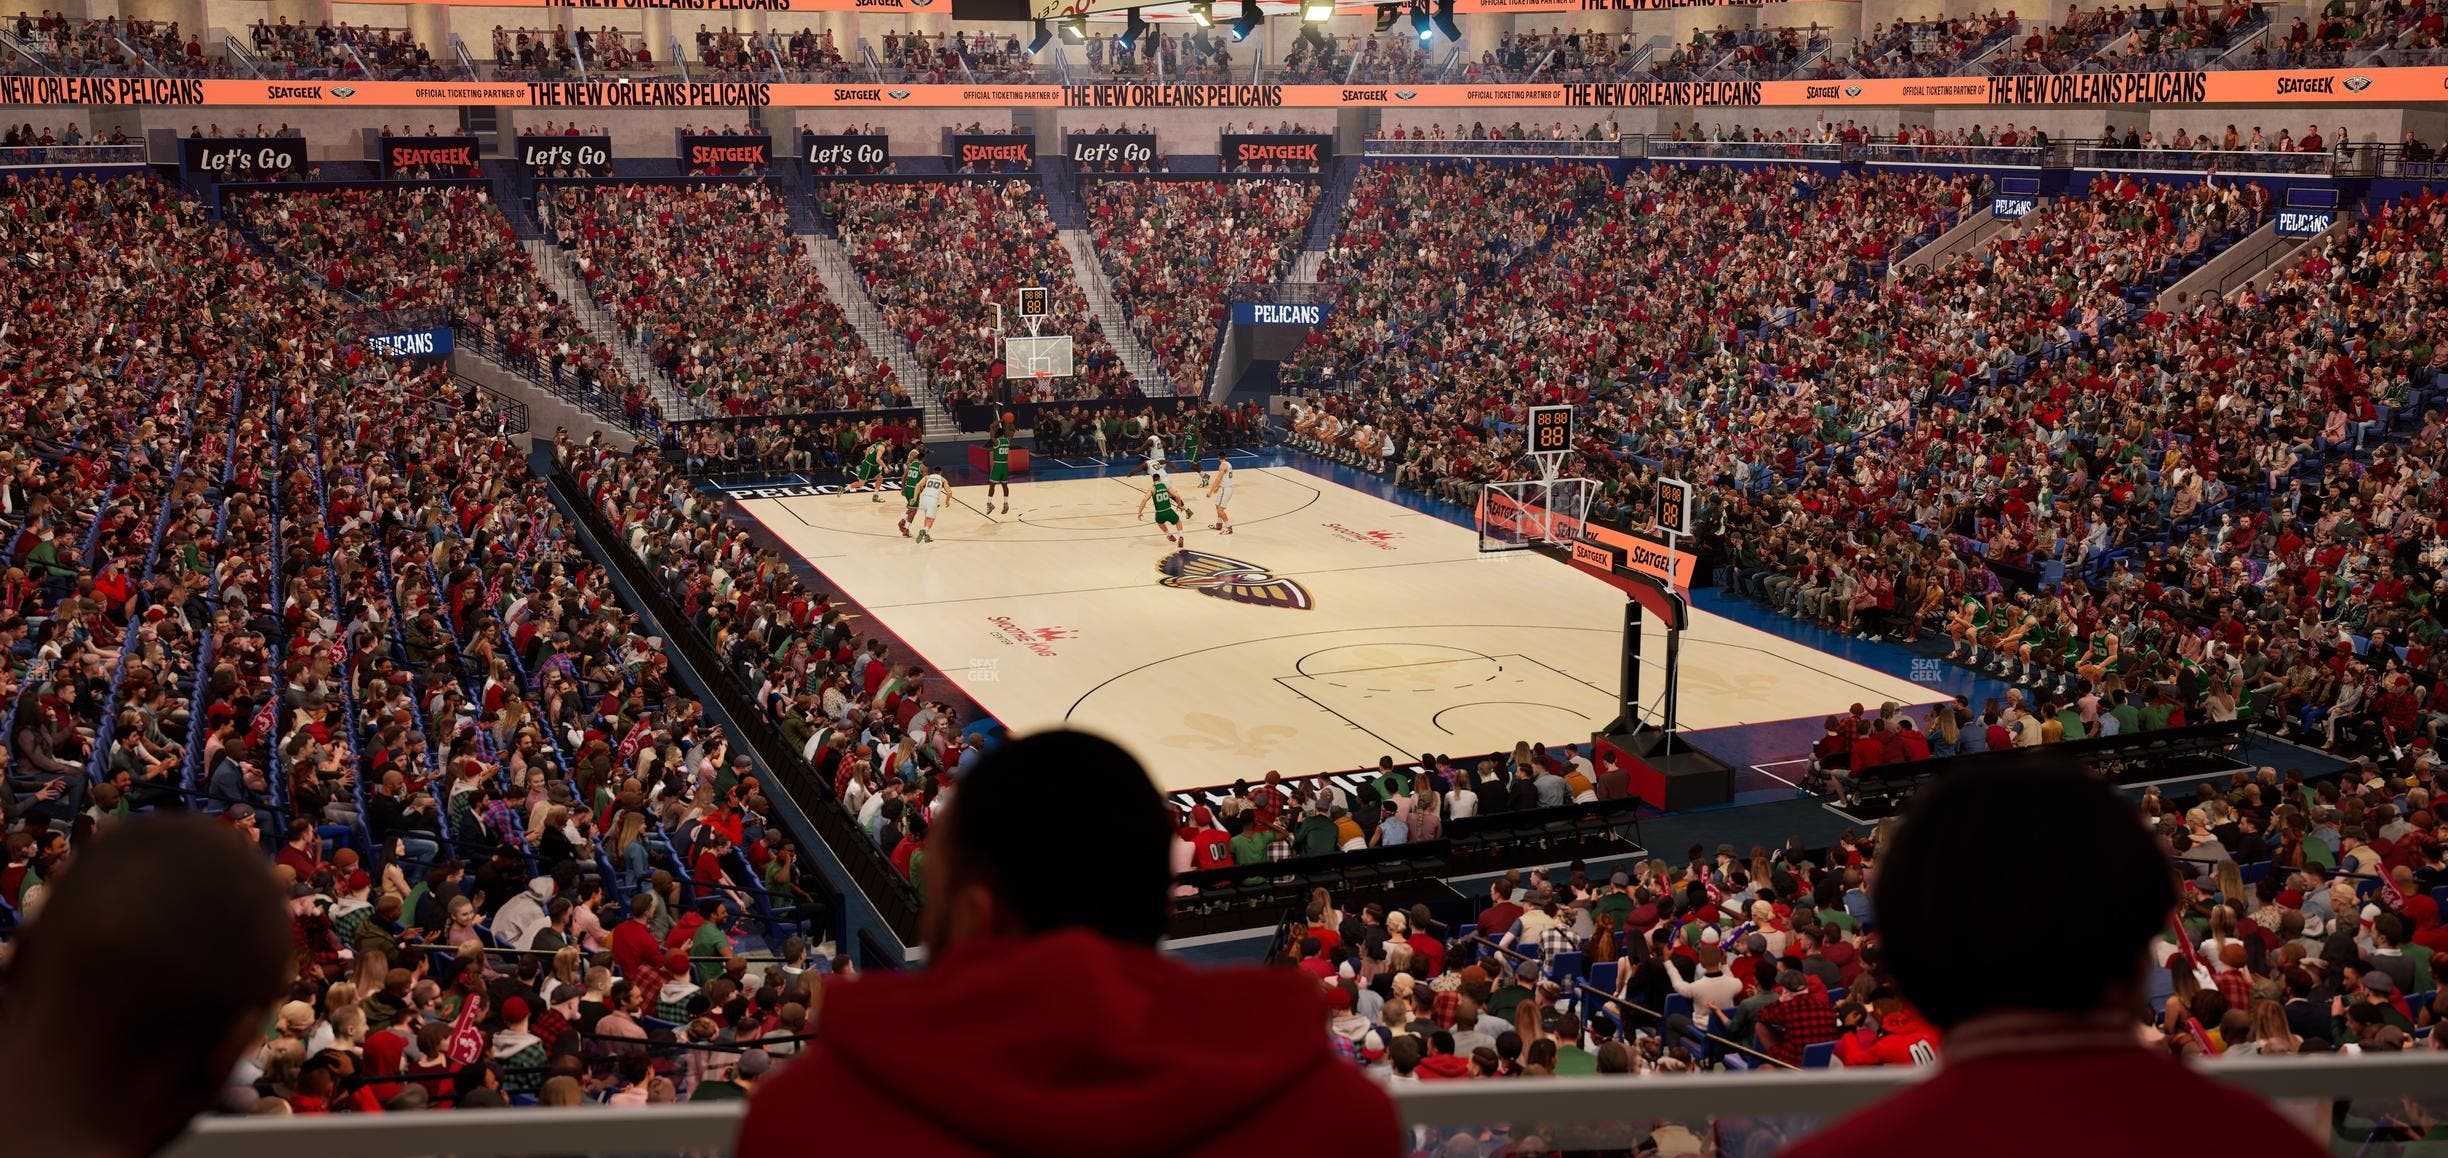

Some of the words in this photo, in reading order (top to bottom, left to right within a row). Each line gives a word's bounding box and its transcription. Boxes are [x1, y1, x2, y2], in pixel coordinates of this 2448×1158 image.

[1, 77, 34, 102] NEW
[38, 78, 116, 104] ORLEANS
[119, 79, 204, 105] PELICANS
[268, 86, 322, 99] SEATGEEK
[416, 89, 446, 99] OFFICIAL
[447, 90, 482, 99] TICKETING
[484, 90, 515, 99] PARTNER
[517, 90, 525, 99] OF
[528, 83, 561, 106] THE
[564, 83, 602, 106] NEW
[607, 83, 686, 106] ORLEANS
[690, 84, 771, 106] PELICANS
[834, 88, 882, 101] SEATGEEK
[1342, 89, 1388, 101] SEATGEEK
[1467, 91, 1492, 100] OFFICIAL
[1494, 91, 1524, 100] TICKETING
[1526, 91, 1551, 99] PARTNER
[1553, 90, 1560, 99] OF
[1564, 84, 1591, 106] THE
[1594, 83, 1627, 105] NEW
[1630, 83, 1690, 105] ORLEANS
[1694, 82, 1761, 105] PELICANS
[1806, 85, 1841, 99] SEATGEEK
[1902, 86, 1925, 97] OFFICIAL
[1926, 86, 1952, 97] TICKETING
[1954, 85, 1976, 95] PARTNER
[1978, 85, 1985, 95] OF
[1987, 77, 2013, 104] THE
[2016, 75, 2048, 103] NEW
[2051, 74, 2122, 103] ORLEANS
[2125, 72, 2206, 102] PELICANS
[2277, 76, 2335, 95] SEATGEEK
[963, 91, 990, 100] OFFICIAL
[992, 91, 1023, 100] TICKETING
[1024, 92, 1050, 101] PARTNER
[1052, 92, 1060, 101] OF
[1062, 85, 1090, 107] THE
[1094, 85, 1129, 107] NEW
[1132, 86, 1204, 107] ORLEANS
[1208, 86, 1281, 106] PELICANS
[201, 148, 252, 170] Let's
[258, 148, 292, 169] Go
[392, 146, 472, 167] SEATGEEK
[525, 146, 572, 166] Let's
[578, 146, 606, 166] Go
[692, 145, 765, 164] SEATGEEK
[809, 144, 852, 163] Let's
[858, 144, 884, 163] Go
[962, 144, 1028, 161] SEATGEEK
[1074, 143, 1118, 161] Let's
[1124, 143, 1151, 161] Go
[1238, 143, 1318, 161] SEATGEEK
[2280, 213, 2329, 232] PELICANS
[1027, 300, 1041, 313] 88
[1254, 304, 1319, 324] PELICANS
[1538, 413, 1551, 425] 88
[1554, 412, 1568, 424] 88
[1541, 427, 1564, 446] 88
[1664, 502, 1679, 527] 88
[1576, 545, 1607, 566] SEATGEEK
[1210, 842, 1226, 862] 00
